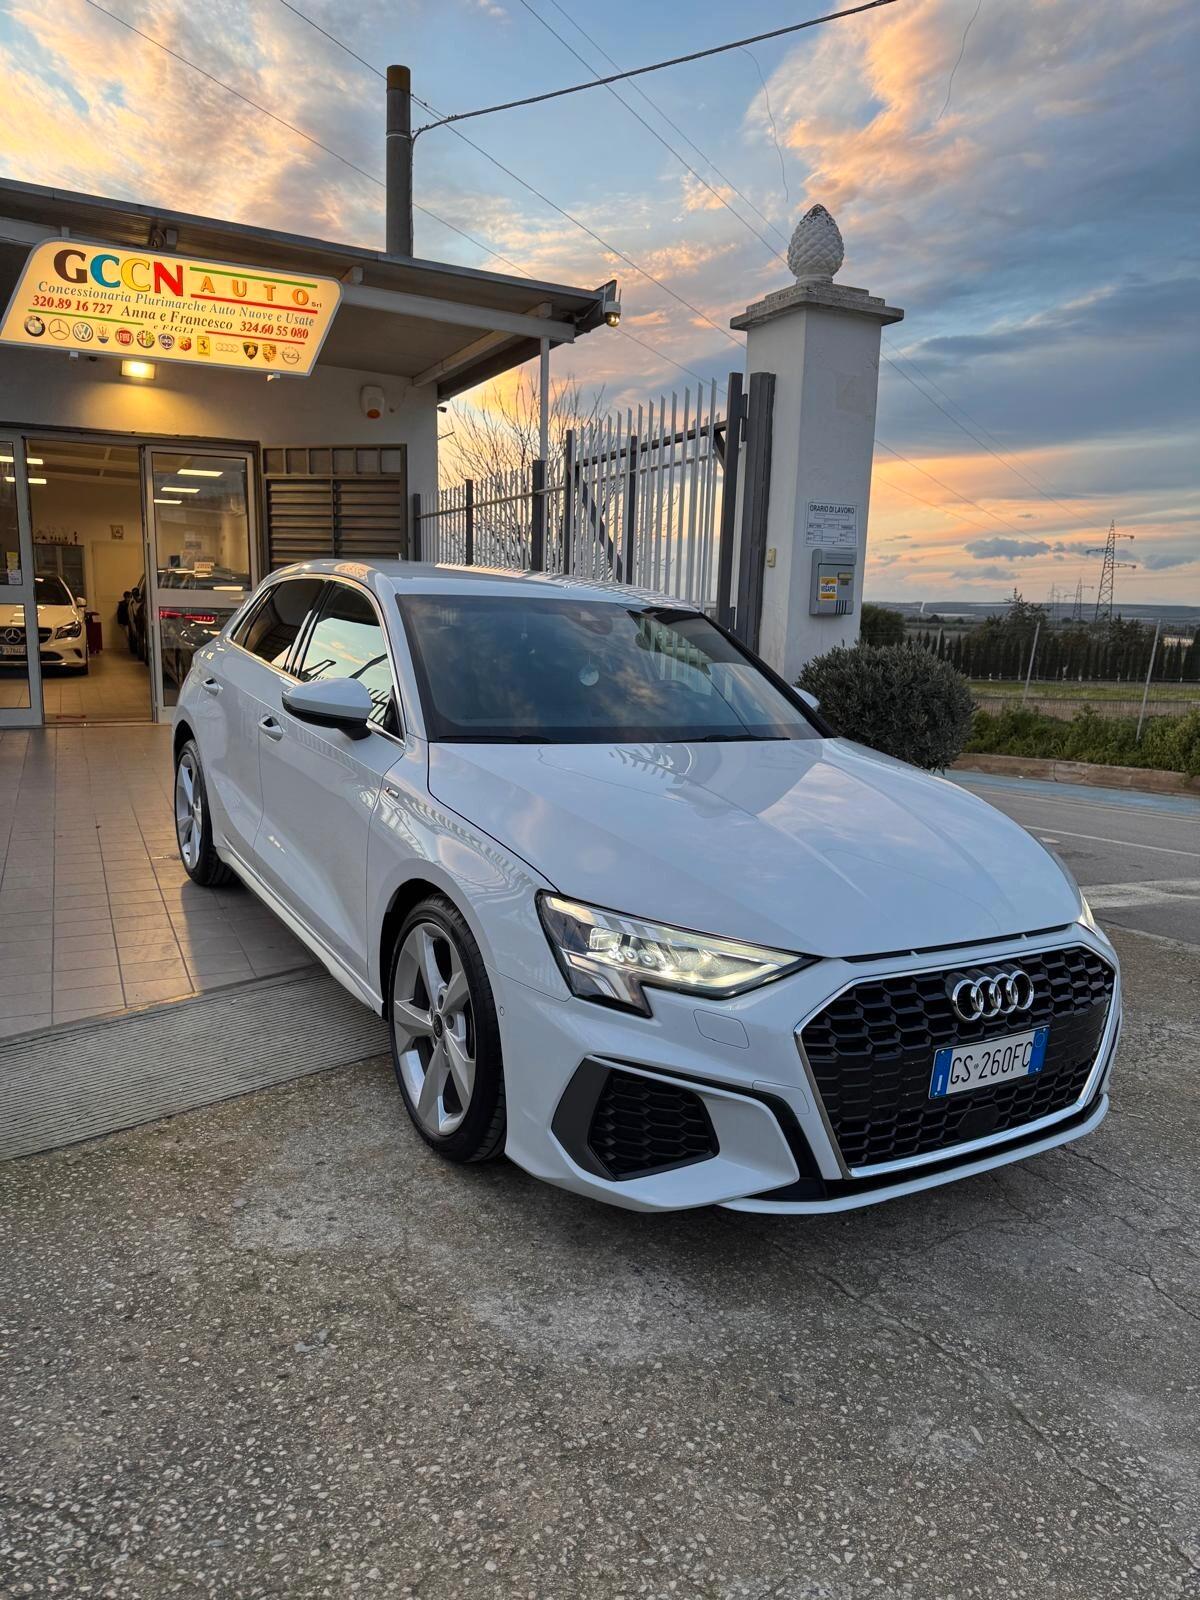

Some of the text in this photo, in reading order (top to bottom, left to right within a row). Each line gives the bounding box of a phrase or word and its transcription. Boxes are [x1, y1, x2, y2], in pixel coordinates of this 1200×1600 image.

[53, 249, 322, 309] GCCN AUTO Srl
[32, 295, 113, 315] 320.89 16 727
[38, 281, 314, 327] Concessionaria Plurimarche Auto Nuove e Usate
[120, 306, 233, 330] Anna e Francesco
[162, 323, 194, 334] FIGLI
[240, 320, 309, 339] 324.60 55 080
[810, 504, 855, 514] ORARIO DI LAVORO
[950, 1041, 1033, 1085] GS 260FC
